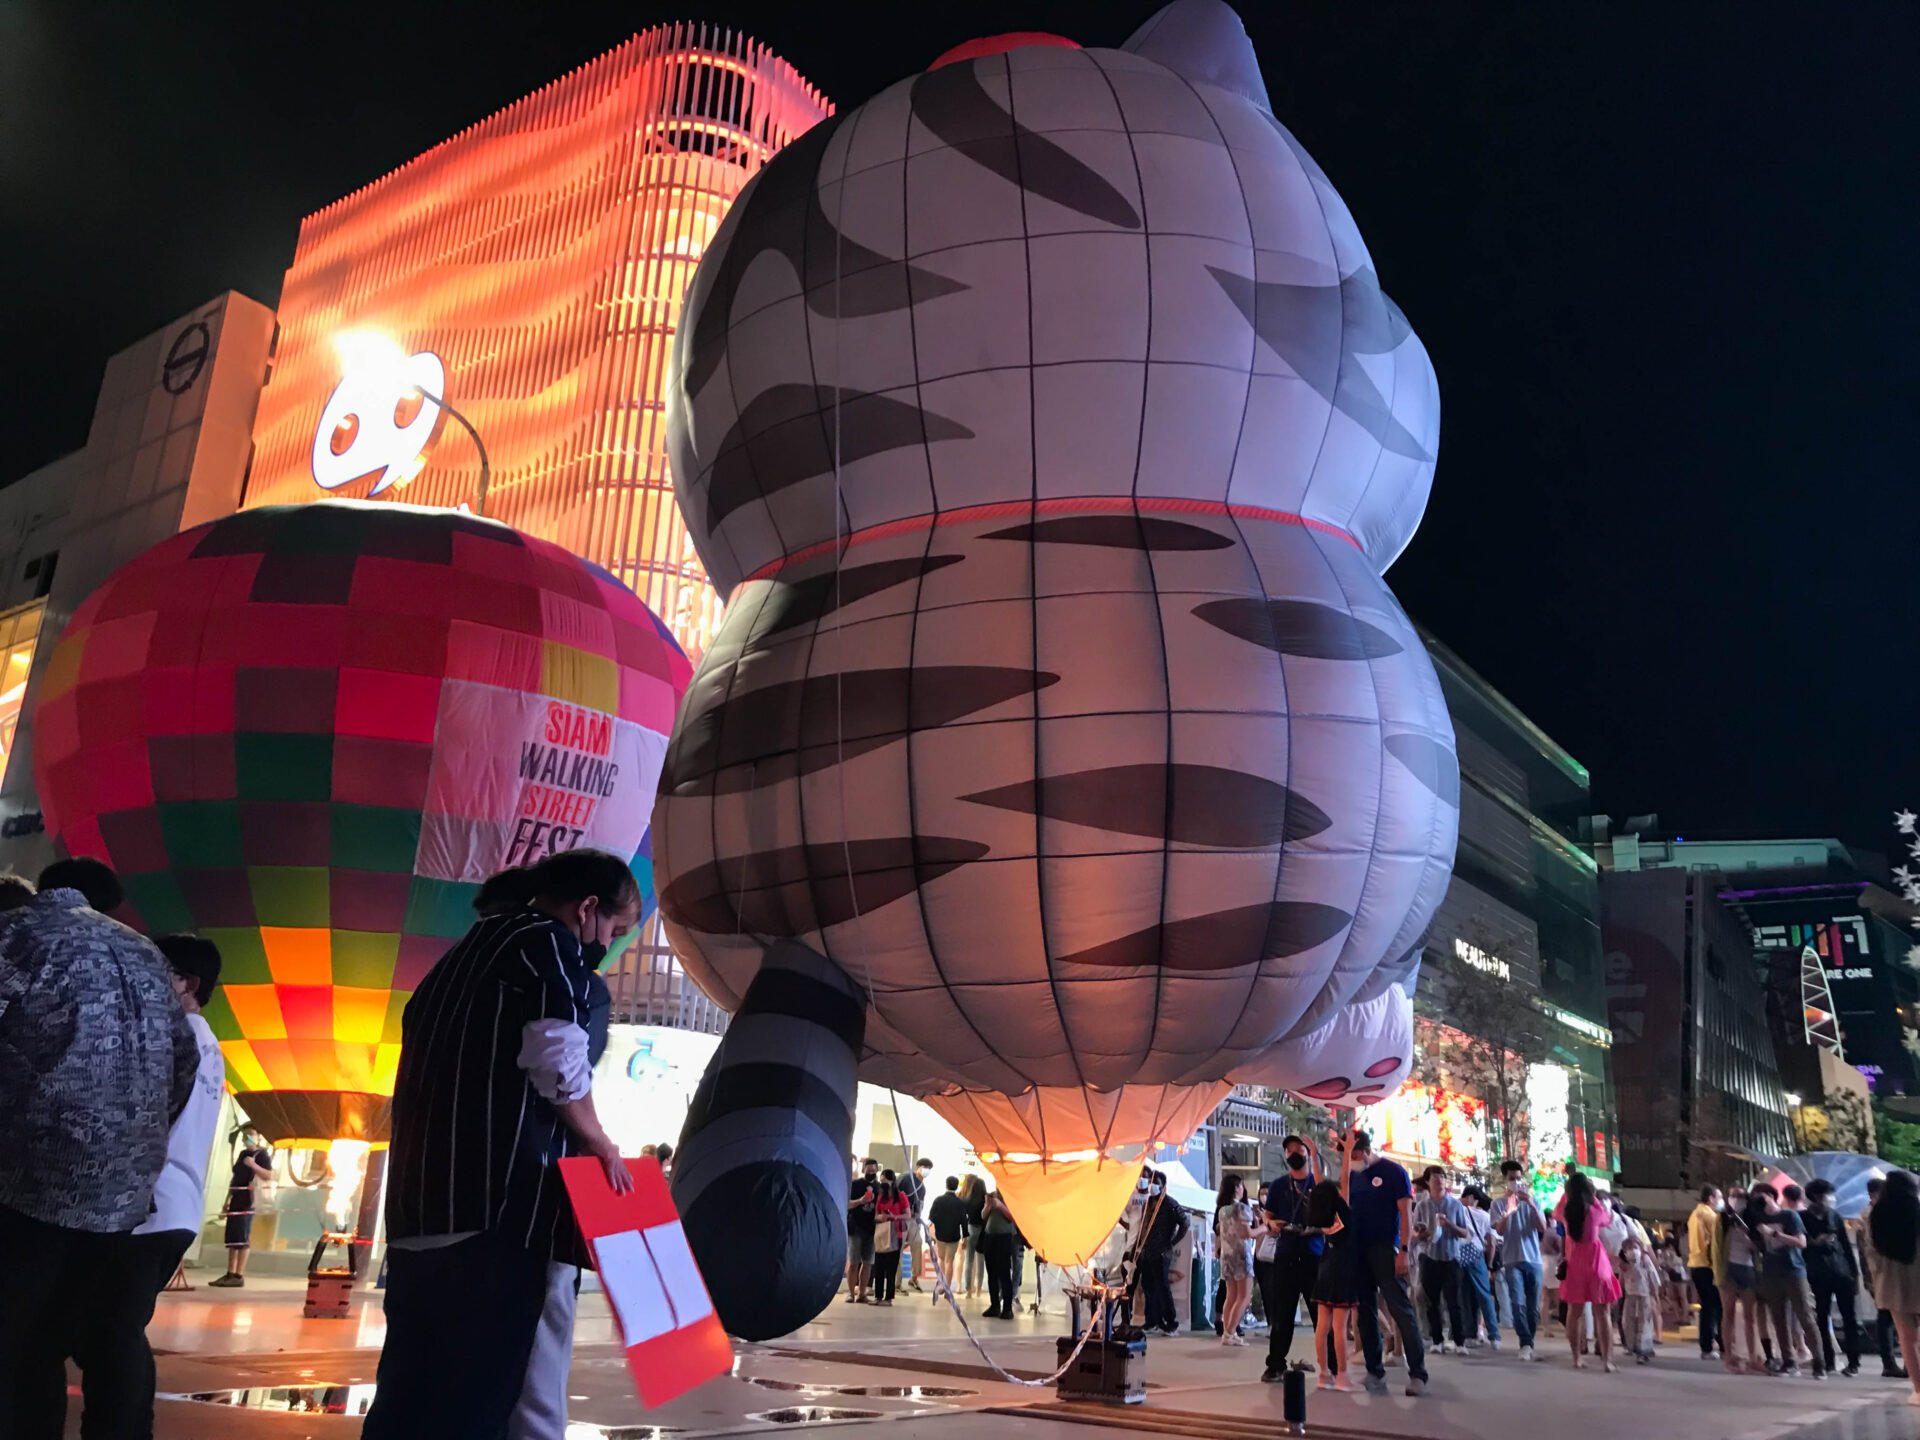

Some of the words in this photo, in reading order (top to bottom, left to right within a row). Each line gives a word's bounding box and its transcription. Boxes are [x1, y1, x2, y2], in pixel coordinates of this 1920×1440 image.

[544, 700, 614, 757] SIAM
[519, 740, 619, 798] WALKING
[523, 784, 596, 826] STREET
[1845, 967, 1873, 979] ONE
